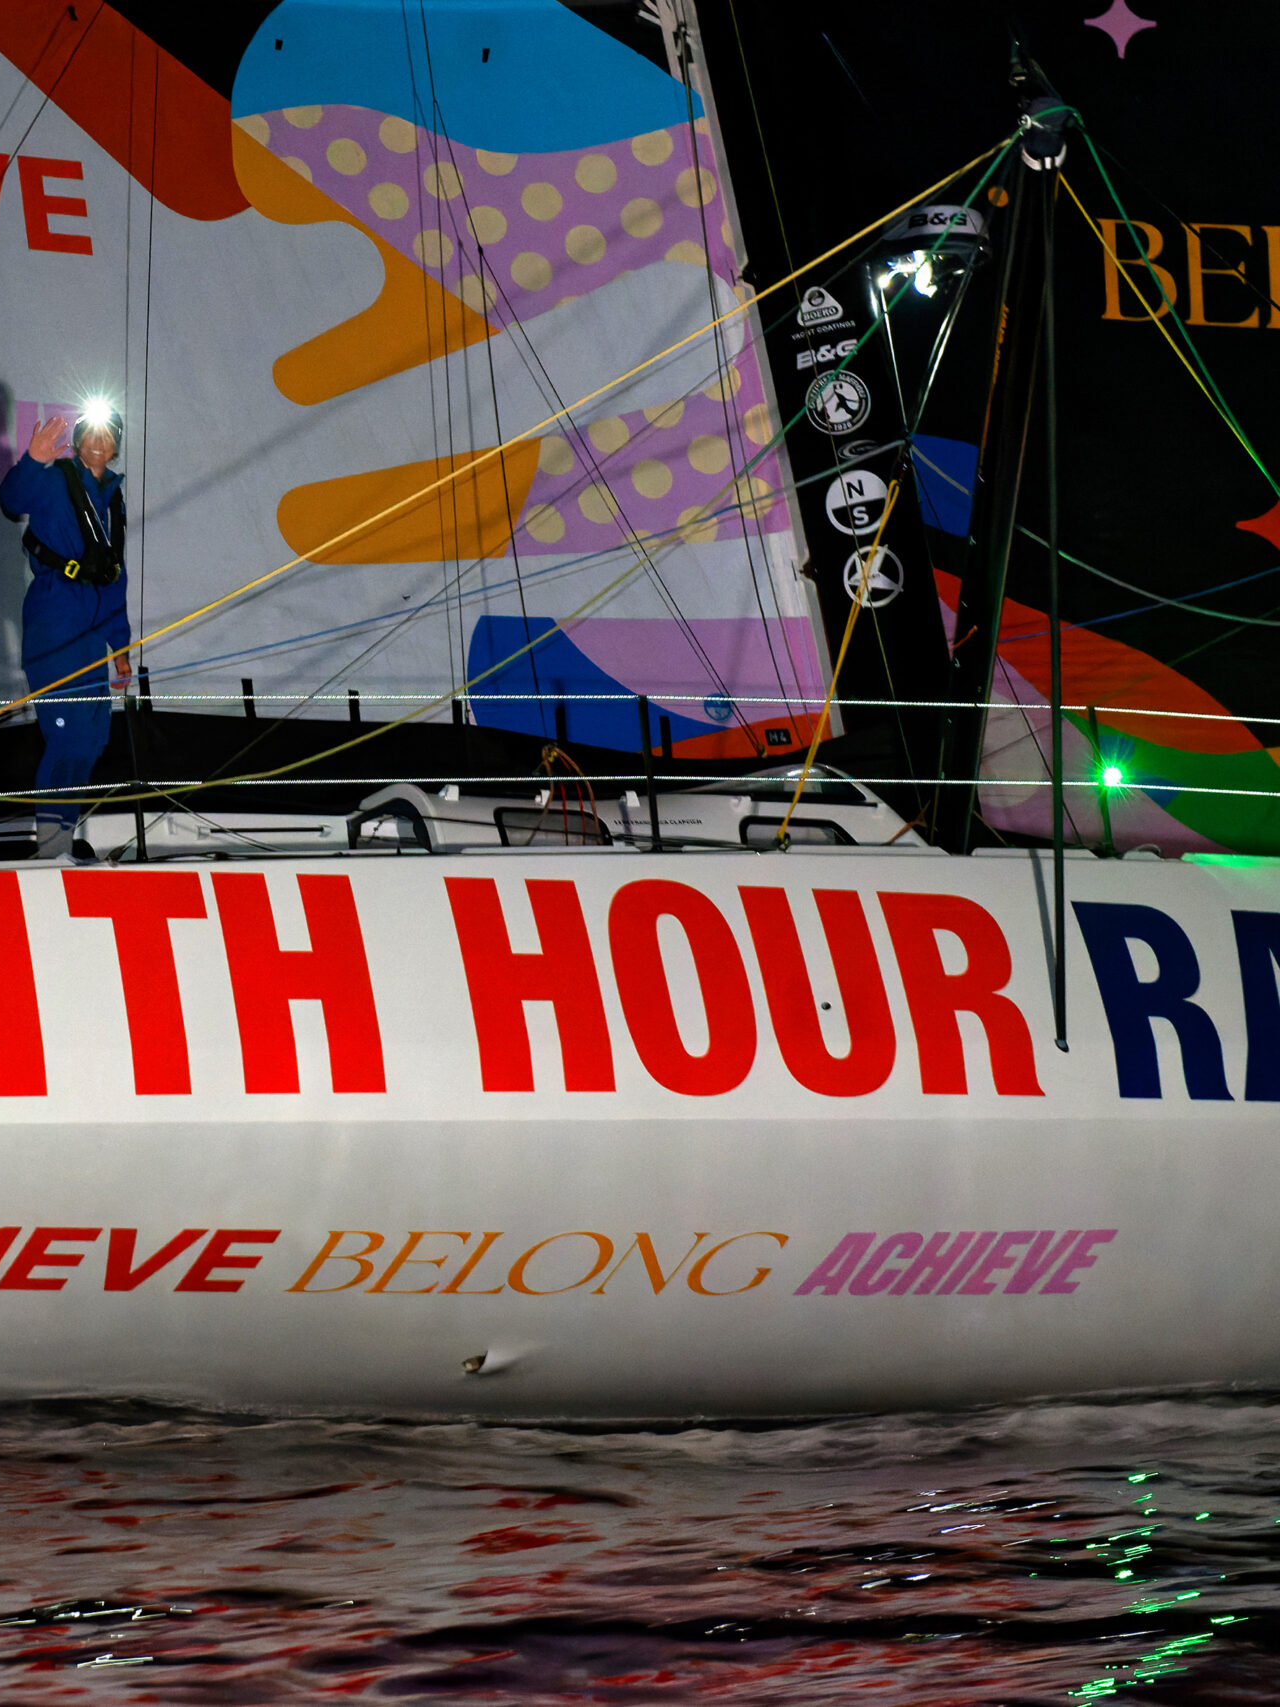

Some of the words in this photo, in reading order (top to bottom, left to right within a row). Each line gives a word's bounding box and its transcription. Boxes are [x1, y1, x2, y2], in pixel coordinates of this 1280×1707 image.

[908, 212, 967, 230] B&G
[797, 338, 858, 370] B&G
[846, 479, 865, 499] N
[853, 506, 869, 525] S
[443, 875, 1047, 1098] HOUR
[284, 1229, 790, 1296] BELONG
[792, 1228, 1119, 1296] ACHIEVE
